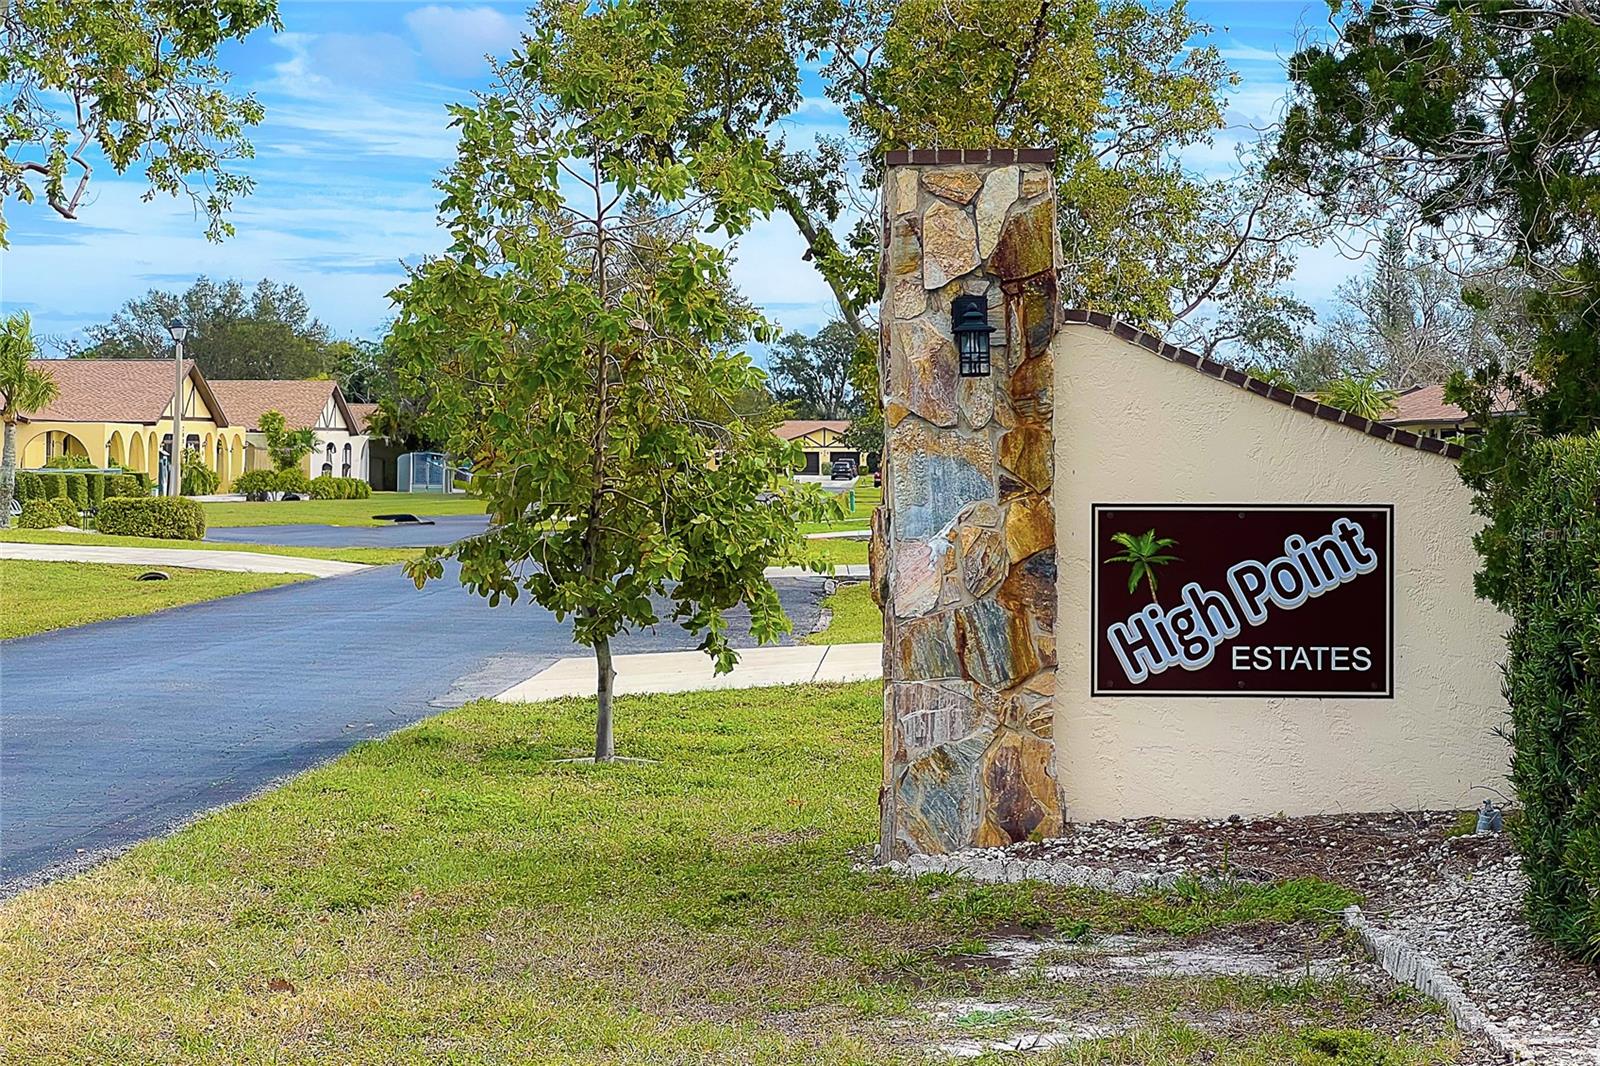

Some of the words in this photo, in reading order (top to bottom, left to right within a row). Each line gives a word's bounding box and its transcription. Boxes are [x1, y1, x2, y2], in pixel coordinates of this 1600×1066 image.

[1107, 582, 1240, 683] High
[1227, 518, 1378, 625] Point
[1231, 645, 1372, 671] ESTATES
